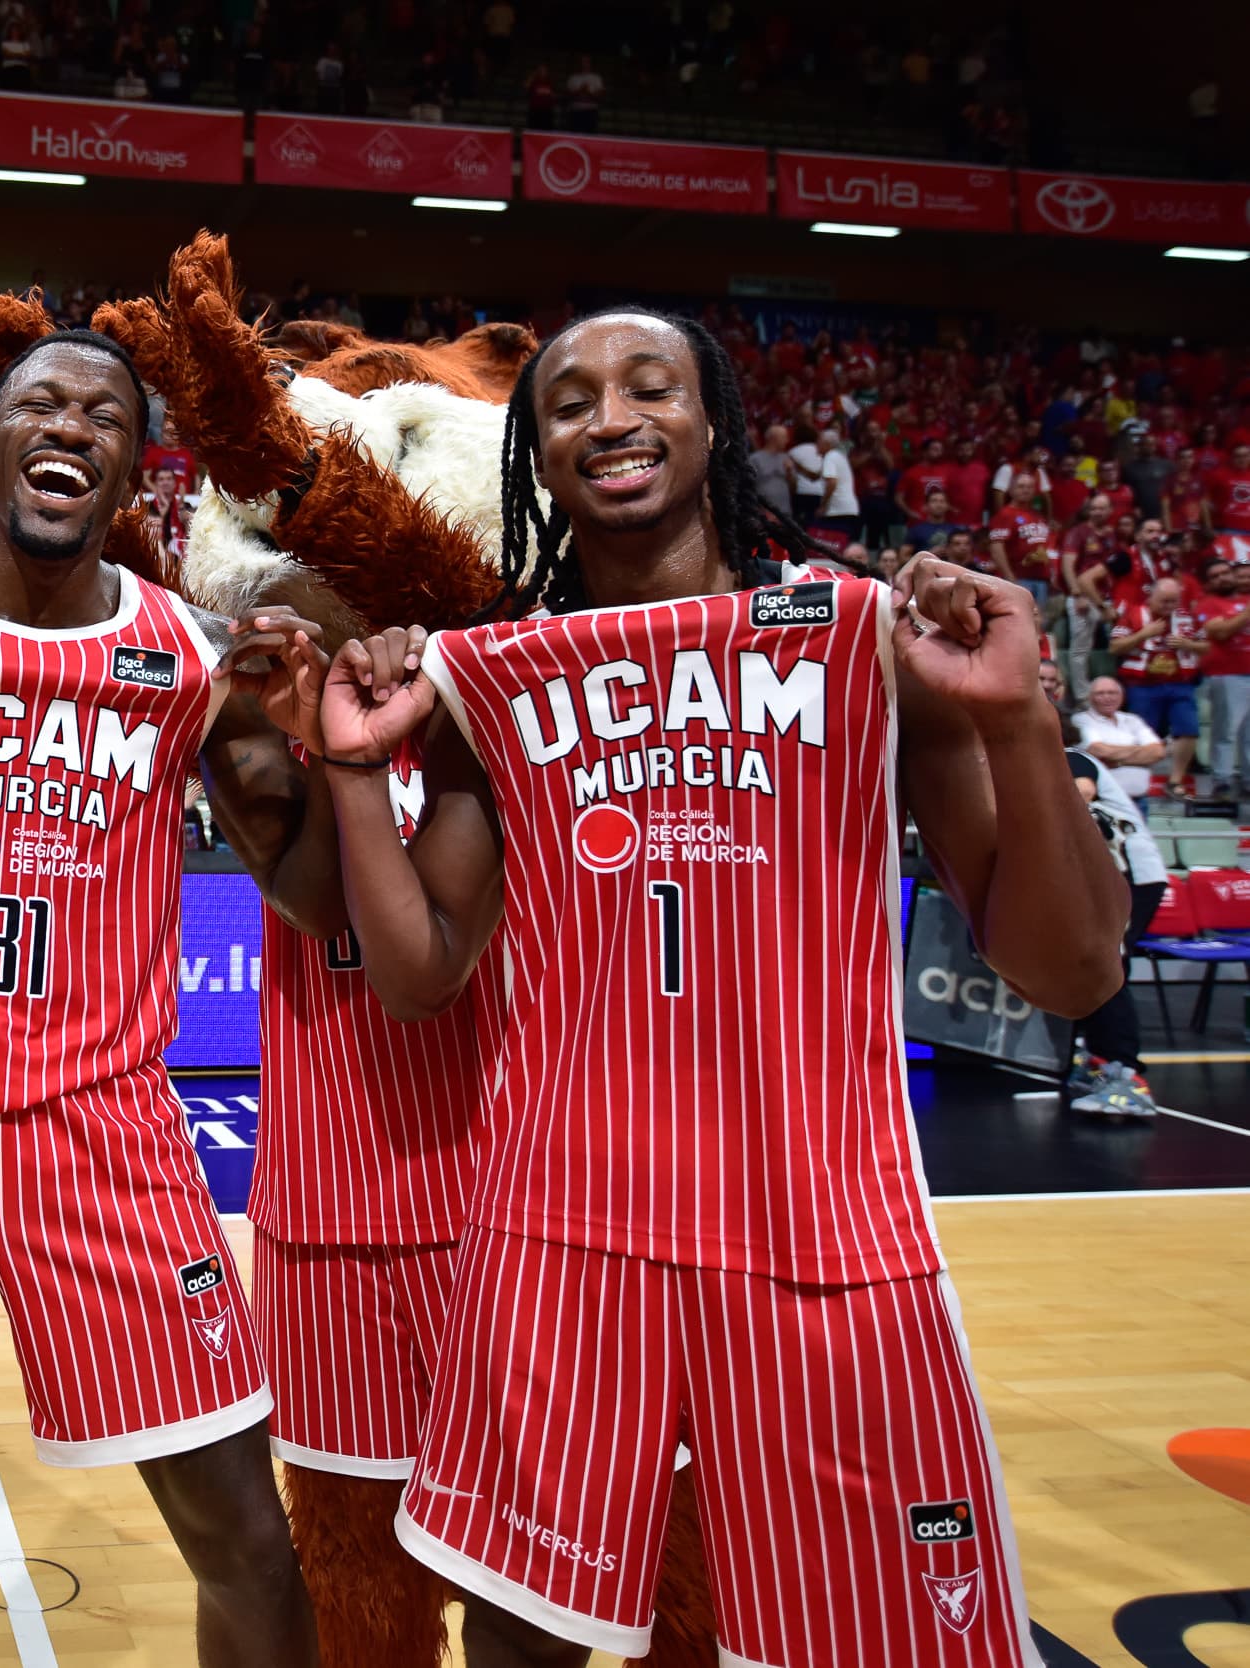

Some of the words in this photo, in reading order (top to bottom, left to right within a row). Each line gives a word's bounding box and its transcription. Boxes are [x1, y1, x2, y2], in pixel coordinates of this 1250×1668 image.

[664, 174, 686, 191] DE
[689, 175, 751, 194] MURCIA
[758, 594, 790, 608] liga
[757, 604, 829, 621] endesa
[118, 655, 143, 669] liga
[116, 667, 171, 684] endesa
[509, 648, 827, 767] UCAM
[572, 744, 776, 808] MURCIA
[649, 809, 676, 820] Costa
[679, 808, 715, 820] Cálida
[13, 828, 39, 838] Costa
[41, 829, 67, 841] Cálida
[647, 822, 731, 843] REGIÓN
[10, 838, 78, 861] REGIÓN
[646, 844, 674, 862] DE
[681, 844, 769, 865] MURCIA
[9, 858, 34, 875] DE
[38, 859, 104, 879] MURCIA
[649, 880, 683, 997] 1
[187, 1271, 216, 1292] acb
[501, 1502, 617, 1572] INVERSUS
[916, 1518, 962, 1537] acb
[940, 1580, 965, 1589] UCAM
